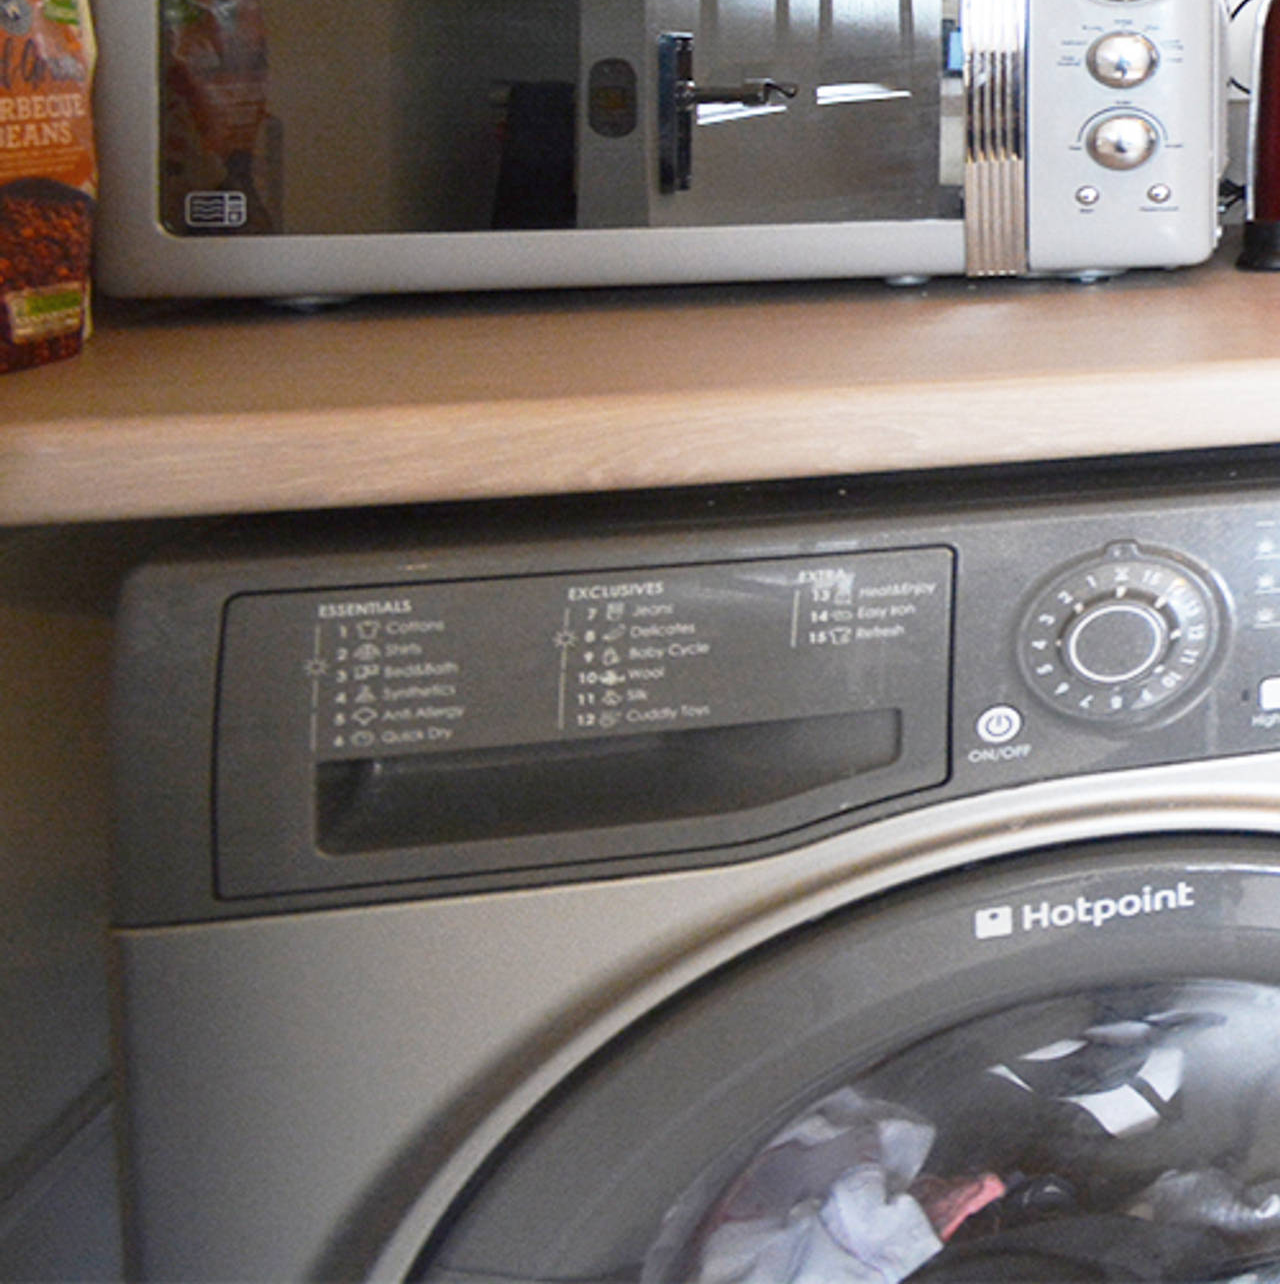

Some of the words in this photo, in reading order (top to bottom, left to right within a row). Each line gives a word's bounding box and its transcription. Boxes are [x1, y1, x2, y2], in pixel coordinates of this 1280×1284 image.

[0, 121, 73, 149] EANS
[568, 580, 665, 601] EXCLUSIVES
[317, 599, 413, 619] ESSENTIALS
[810, 609, 829, 624] 14
[385, 620, 446, 635] Cottons
[629, 622, 697, 639] Delicates
[808, 630, 828, 645] 15
[628, 646, 666, 661] Baby
[667, 641, 712, 659] Cycle
[578, 671, 599, 685] 10
[627, 666, 666, 681] Wool
[382, 684, 457, 701] Synthetics
[577, 692, 596, 706] 11
[415, 705, 465, 721] Allergy
[576, 712, 597, 727] 12
[1252, 711, 1280, 729] High
[380, 730, 425, 744] Quick
[427, 726, 454, 741] Dry
[967, 743, 1033, 764] ON/OFF
[1022, 882, 1195, 932] Hotpoint
